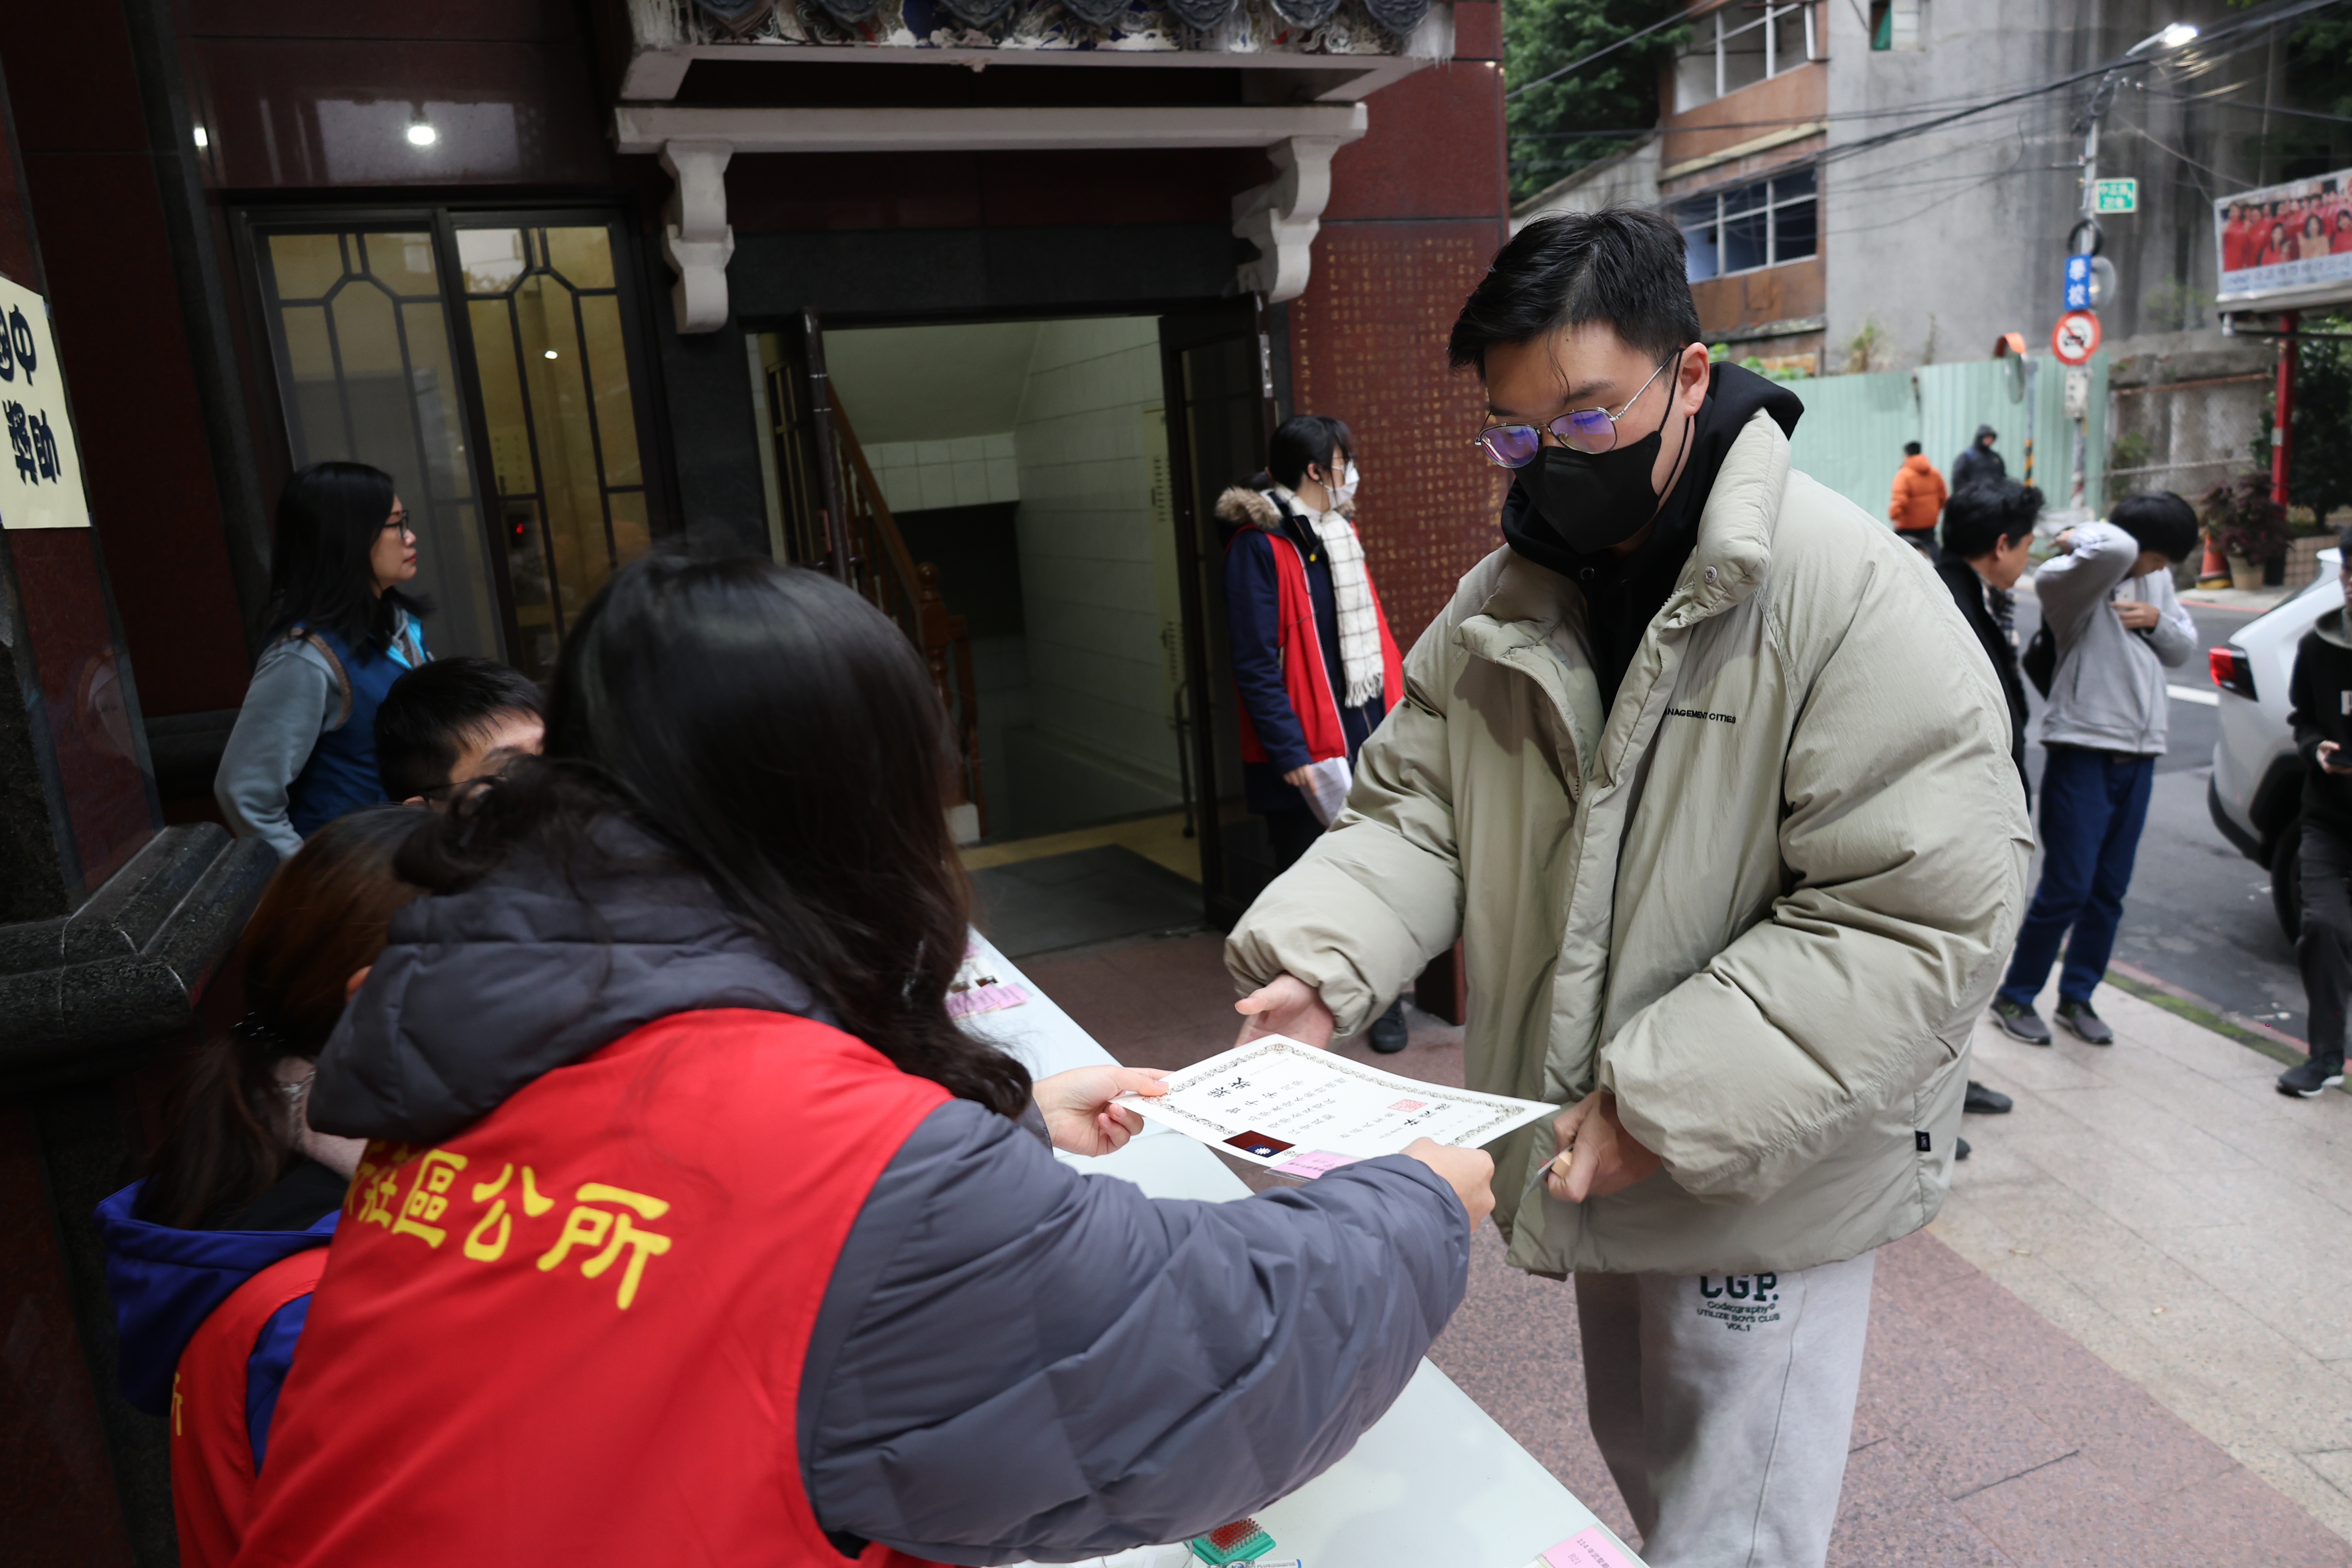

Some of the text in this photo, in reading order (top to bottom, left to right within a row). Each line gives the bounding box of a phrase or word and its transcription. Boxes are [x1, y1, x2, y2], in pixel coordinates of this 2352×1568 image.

[2, 399, 62, 487] 獎助
[1667, 708, 1736, 724] NAGEMENT CITIES
[1207, 1076, 1253, 1098] 獎狀
[1697, 1308, 1780, 1323] UTILIZE BOYS CLUB
[1725, 1321, 1751, 1332] VOL.1
[1577, 1538, 1589, 1548] 114
[1568, 1553, 1582, 1565] B21
